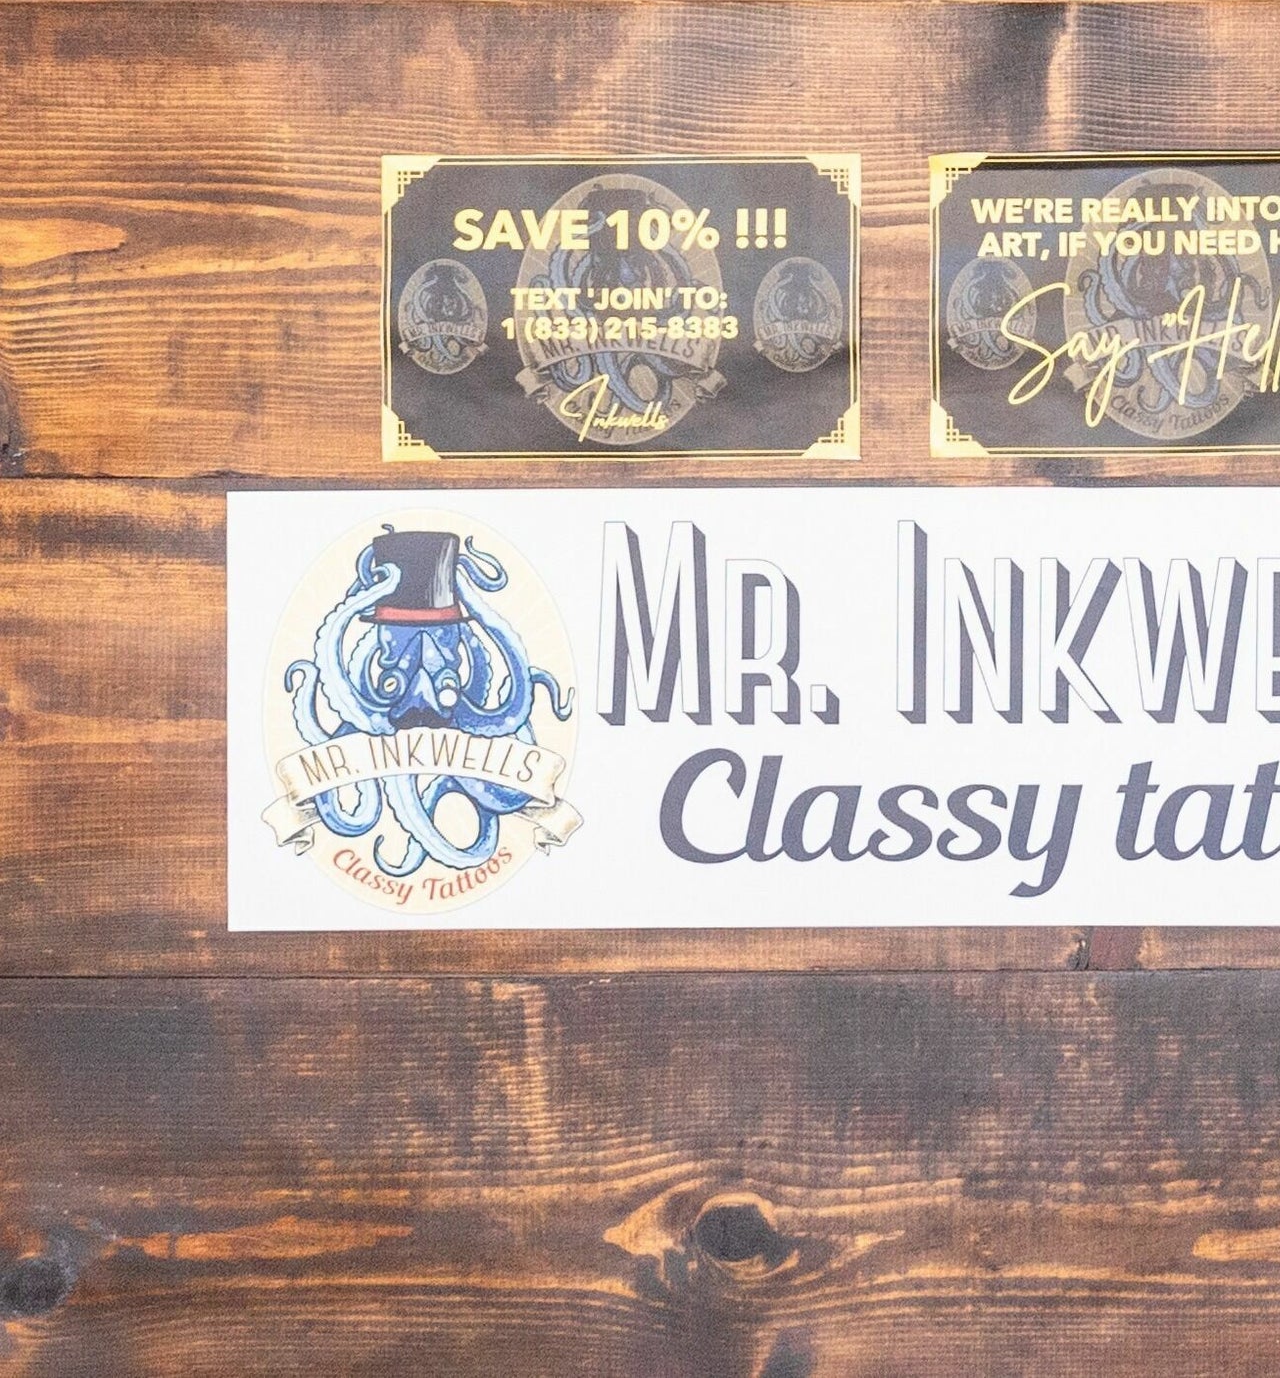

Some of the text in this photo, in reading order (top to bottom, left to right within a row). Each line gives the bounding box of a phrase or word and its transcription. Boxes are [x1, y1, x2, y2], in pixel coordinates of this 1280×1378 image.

[452, 207, 788, 252] SAVE 10% !!!
[970, 197, 1074, 225] WE'RE
[1081, 195, 1200, 225] REALLY
[977, 231, 1050, 261] ART,
[1058, 230, 1088, 258] IF
[1096, 230, 1166, 257] YOU
[1174, 229, 1261, 257] NEED
[510, 286, 729, 311] TEXT 'JOIN' TO:
[500, 315, 740, 344] 1 (833) 215-8383
[999, 281, 1140, 428] Say
[558, 374, 669, 443] Inkwells
[597, 518, 841, 726] MR.
[298, 732, 542, 786] MR. INKWELLS
[657, 745, 1085, 898] Classy
[332, 845, 514, 906] Classy Tattoos
